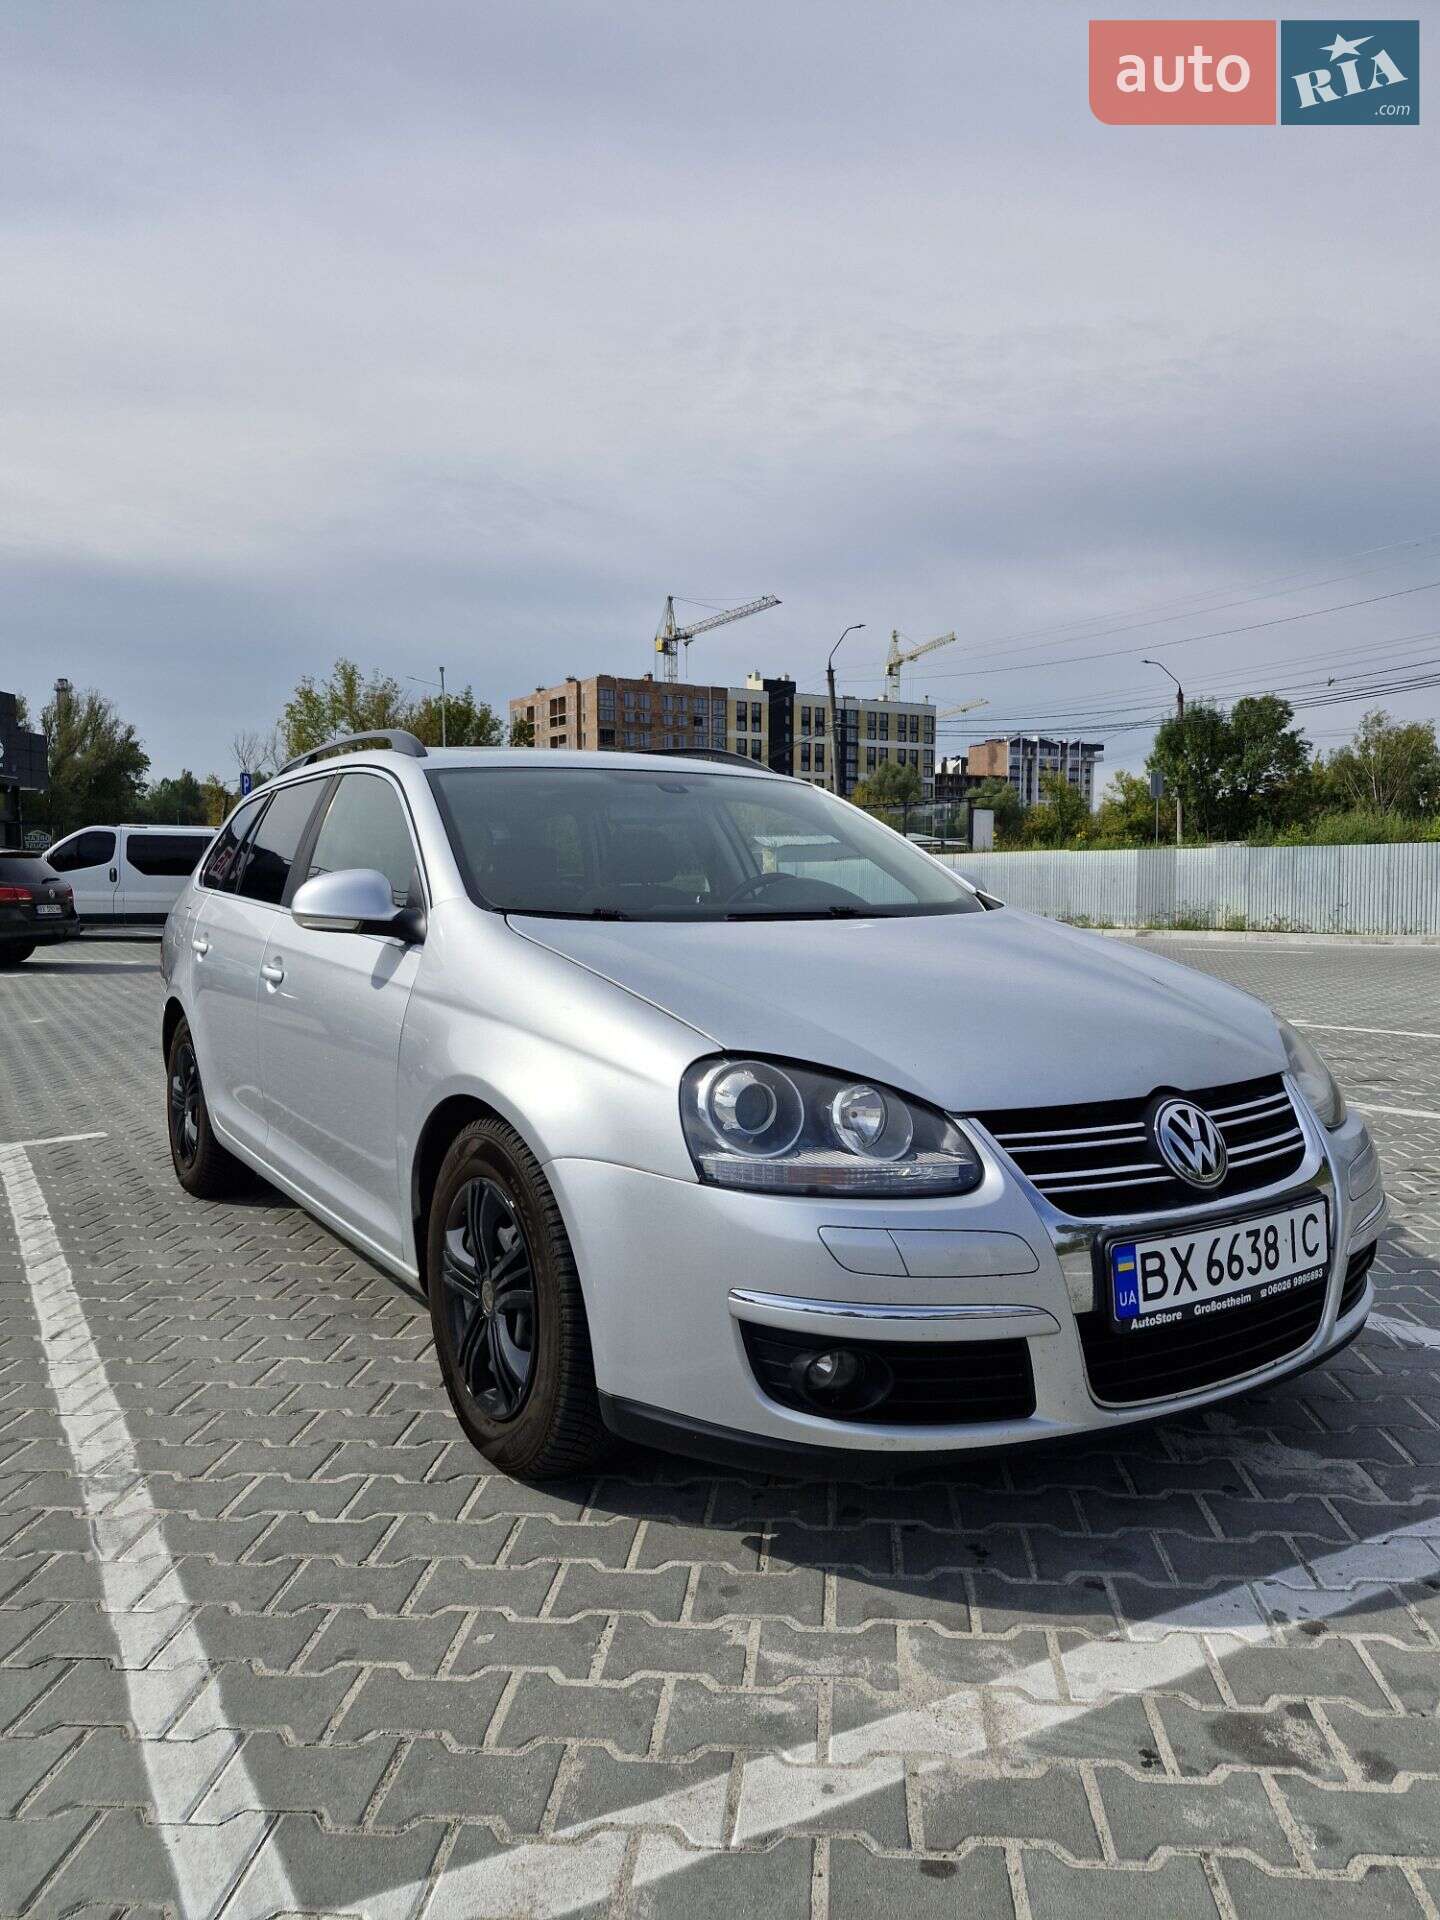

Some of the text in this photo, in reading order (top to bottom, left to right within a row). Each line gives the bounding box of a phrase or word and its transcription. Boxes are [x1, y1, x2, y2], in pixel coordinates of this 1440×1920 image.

[1140, 1213, 1320, 1303] BX 6638 IC
[1119, 1289, 1137, 1307] UA
[1130, 1311, 1183, 1331] AutoStore
[1193, 1293, 1252, 1316] Großostheim
[1267, 1279, 1291, 1295] 06026
